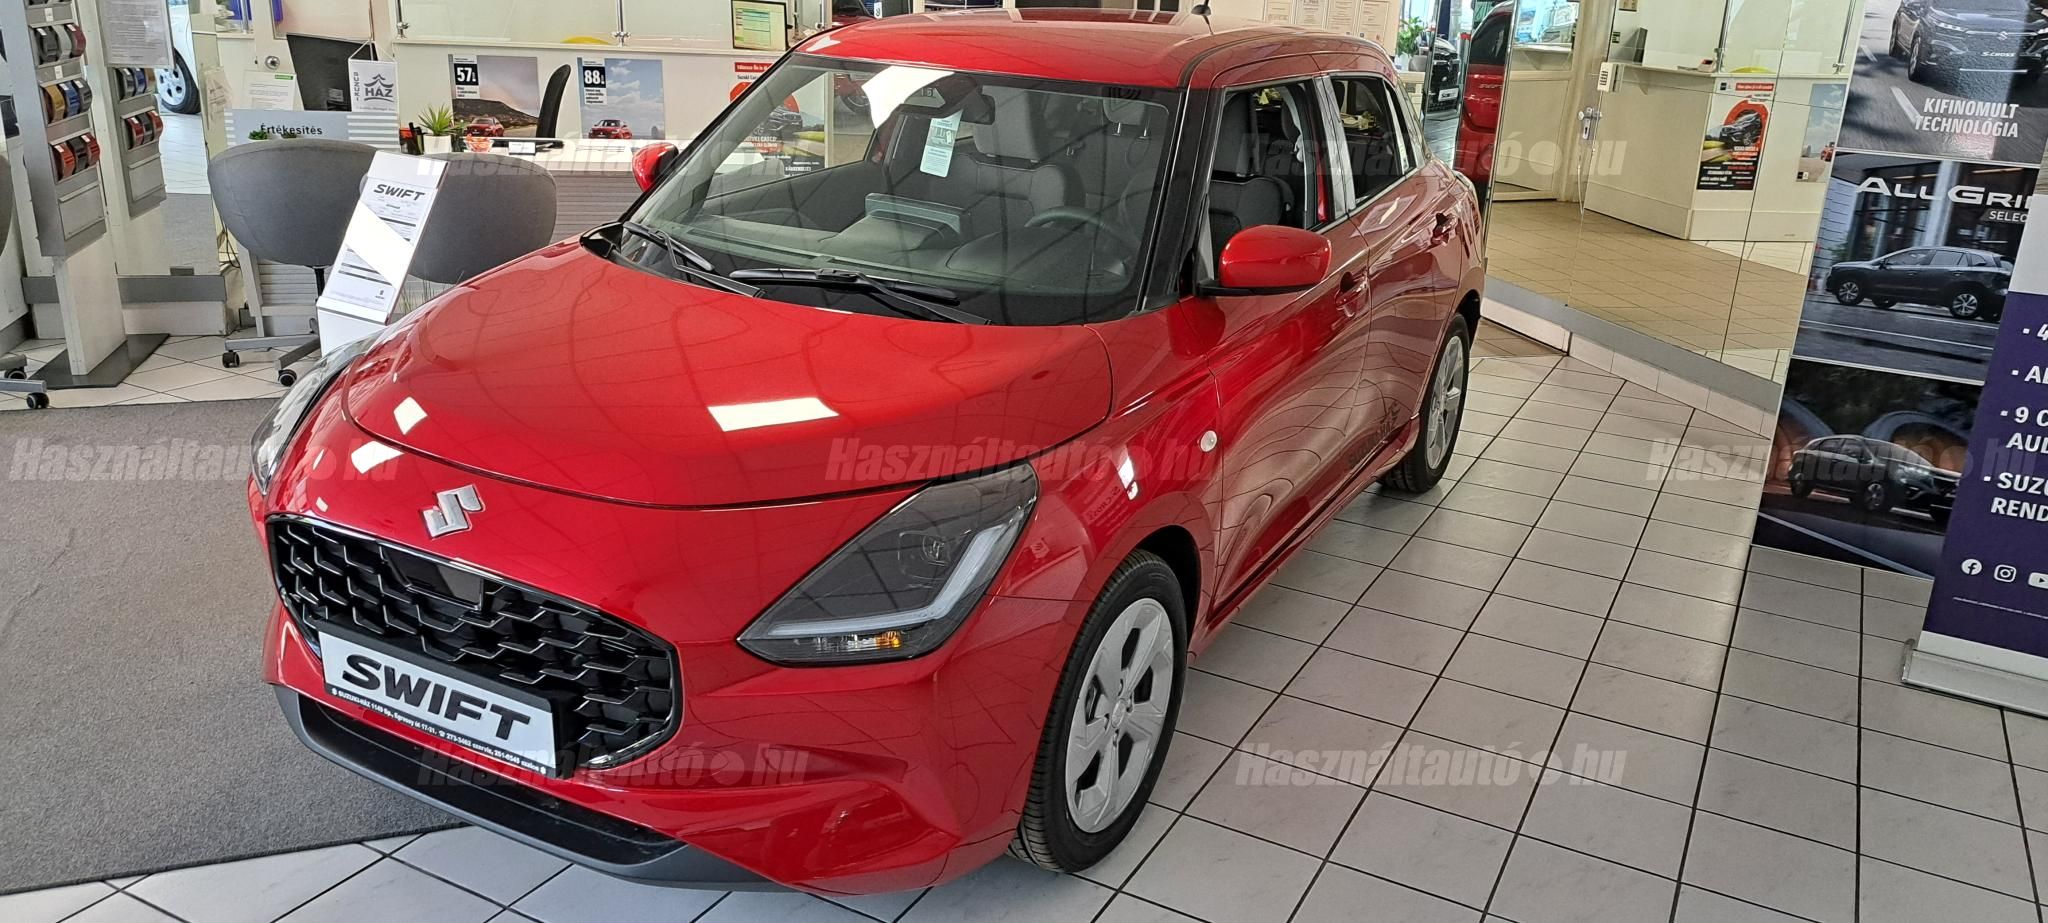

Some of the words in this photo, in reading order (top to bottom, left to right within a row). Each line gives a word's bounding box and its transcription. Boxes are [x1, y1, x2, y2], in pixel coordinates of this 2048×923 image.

[457, 67, 473, 82] 57
[584, 69, 601, 84] 88
[1924, 98, 2019, 119] KIFINOMULT
[260, 123, 323, 135] Értékesítés
[1914, 115, 2019, 138] TECHNOLÓGIA
[373, 183, 426, 201] SWIFT
[2014, 406, 2030, 424] 9
[342, 654, 531, 740] SWIFT
